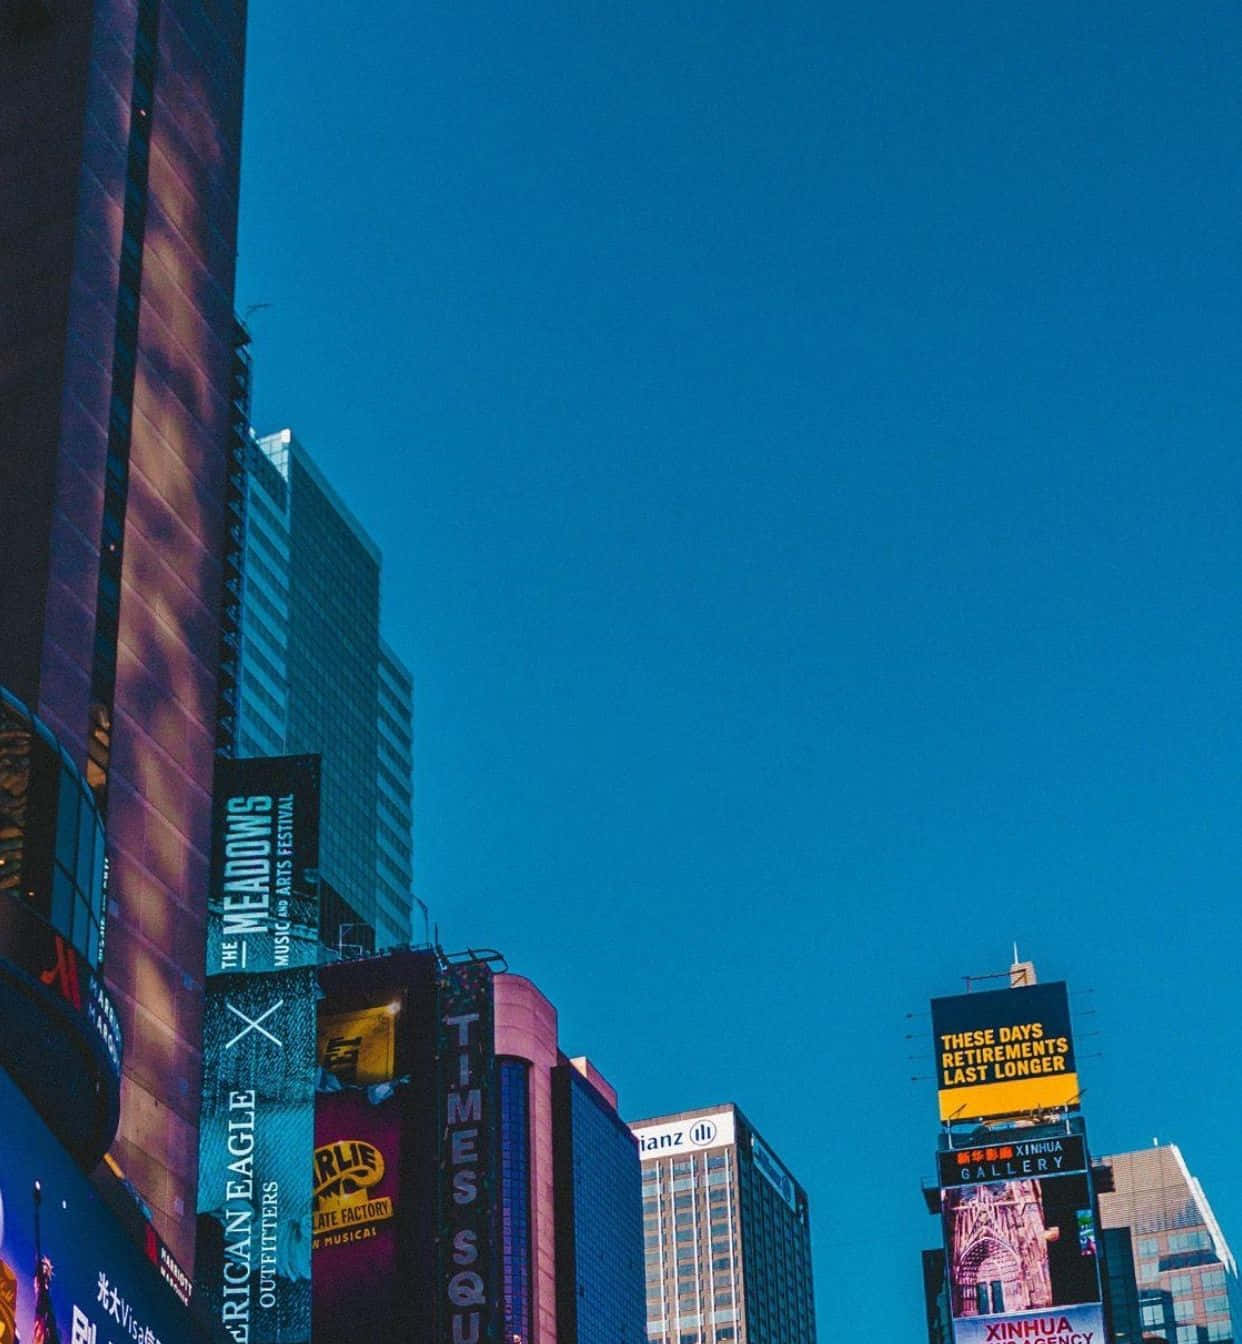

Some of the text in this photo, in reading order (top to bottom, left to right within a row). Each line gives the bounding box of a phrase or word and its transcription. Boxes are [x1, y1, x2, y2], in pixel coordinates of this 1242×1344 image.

[221, 795, 273, 968] THE MEADOWS
[274, 794, 295, 966] MUSIC AND ARTS FESTIVAL
[941, 1023, 1043, 1051] THESE DAYS
[942, 1037, 1069, 1068] RETIREMENTS
[943, 1056, 1066, 1085] LAST LONGER
[446, 1013, 482, 1204] TIMES
[226, 1090, 256, 1201] EAGLE
[1016, 1141, 1063, 1157] XINHUA
[314, 1143, 377, 1188] RLIE
[961, 1156, 1063, 1180] GALLERY
[341, 1200, 388, 1225] FACTORY
[259, 1181, 279, 1309] OUTFITTERS
[324, 1226, 377, 1247] MUSICAL
[986, 1316, 1073, 1342] XINHUA
